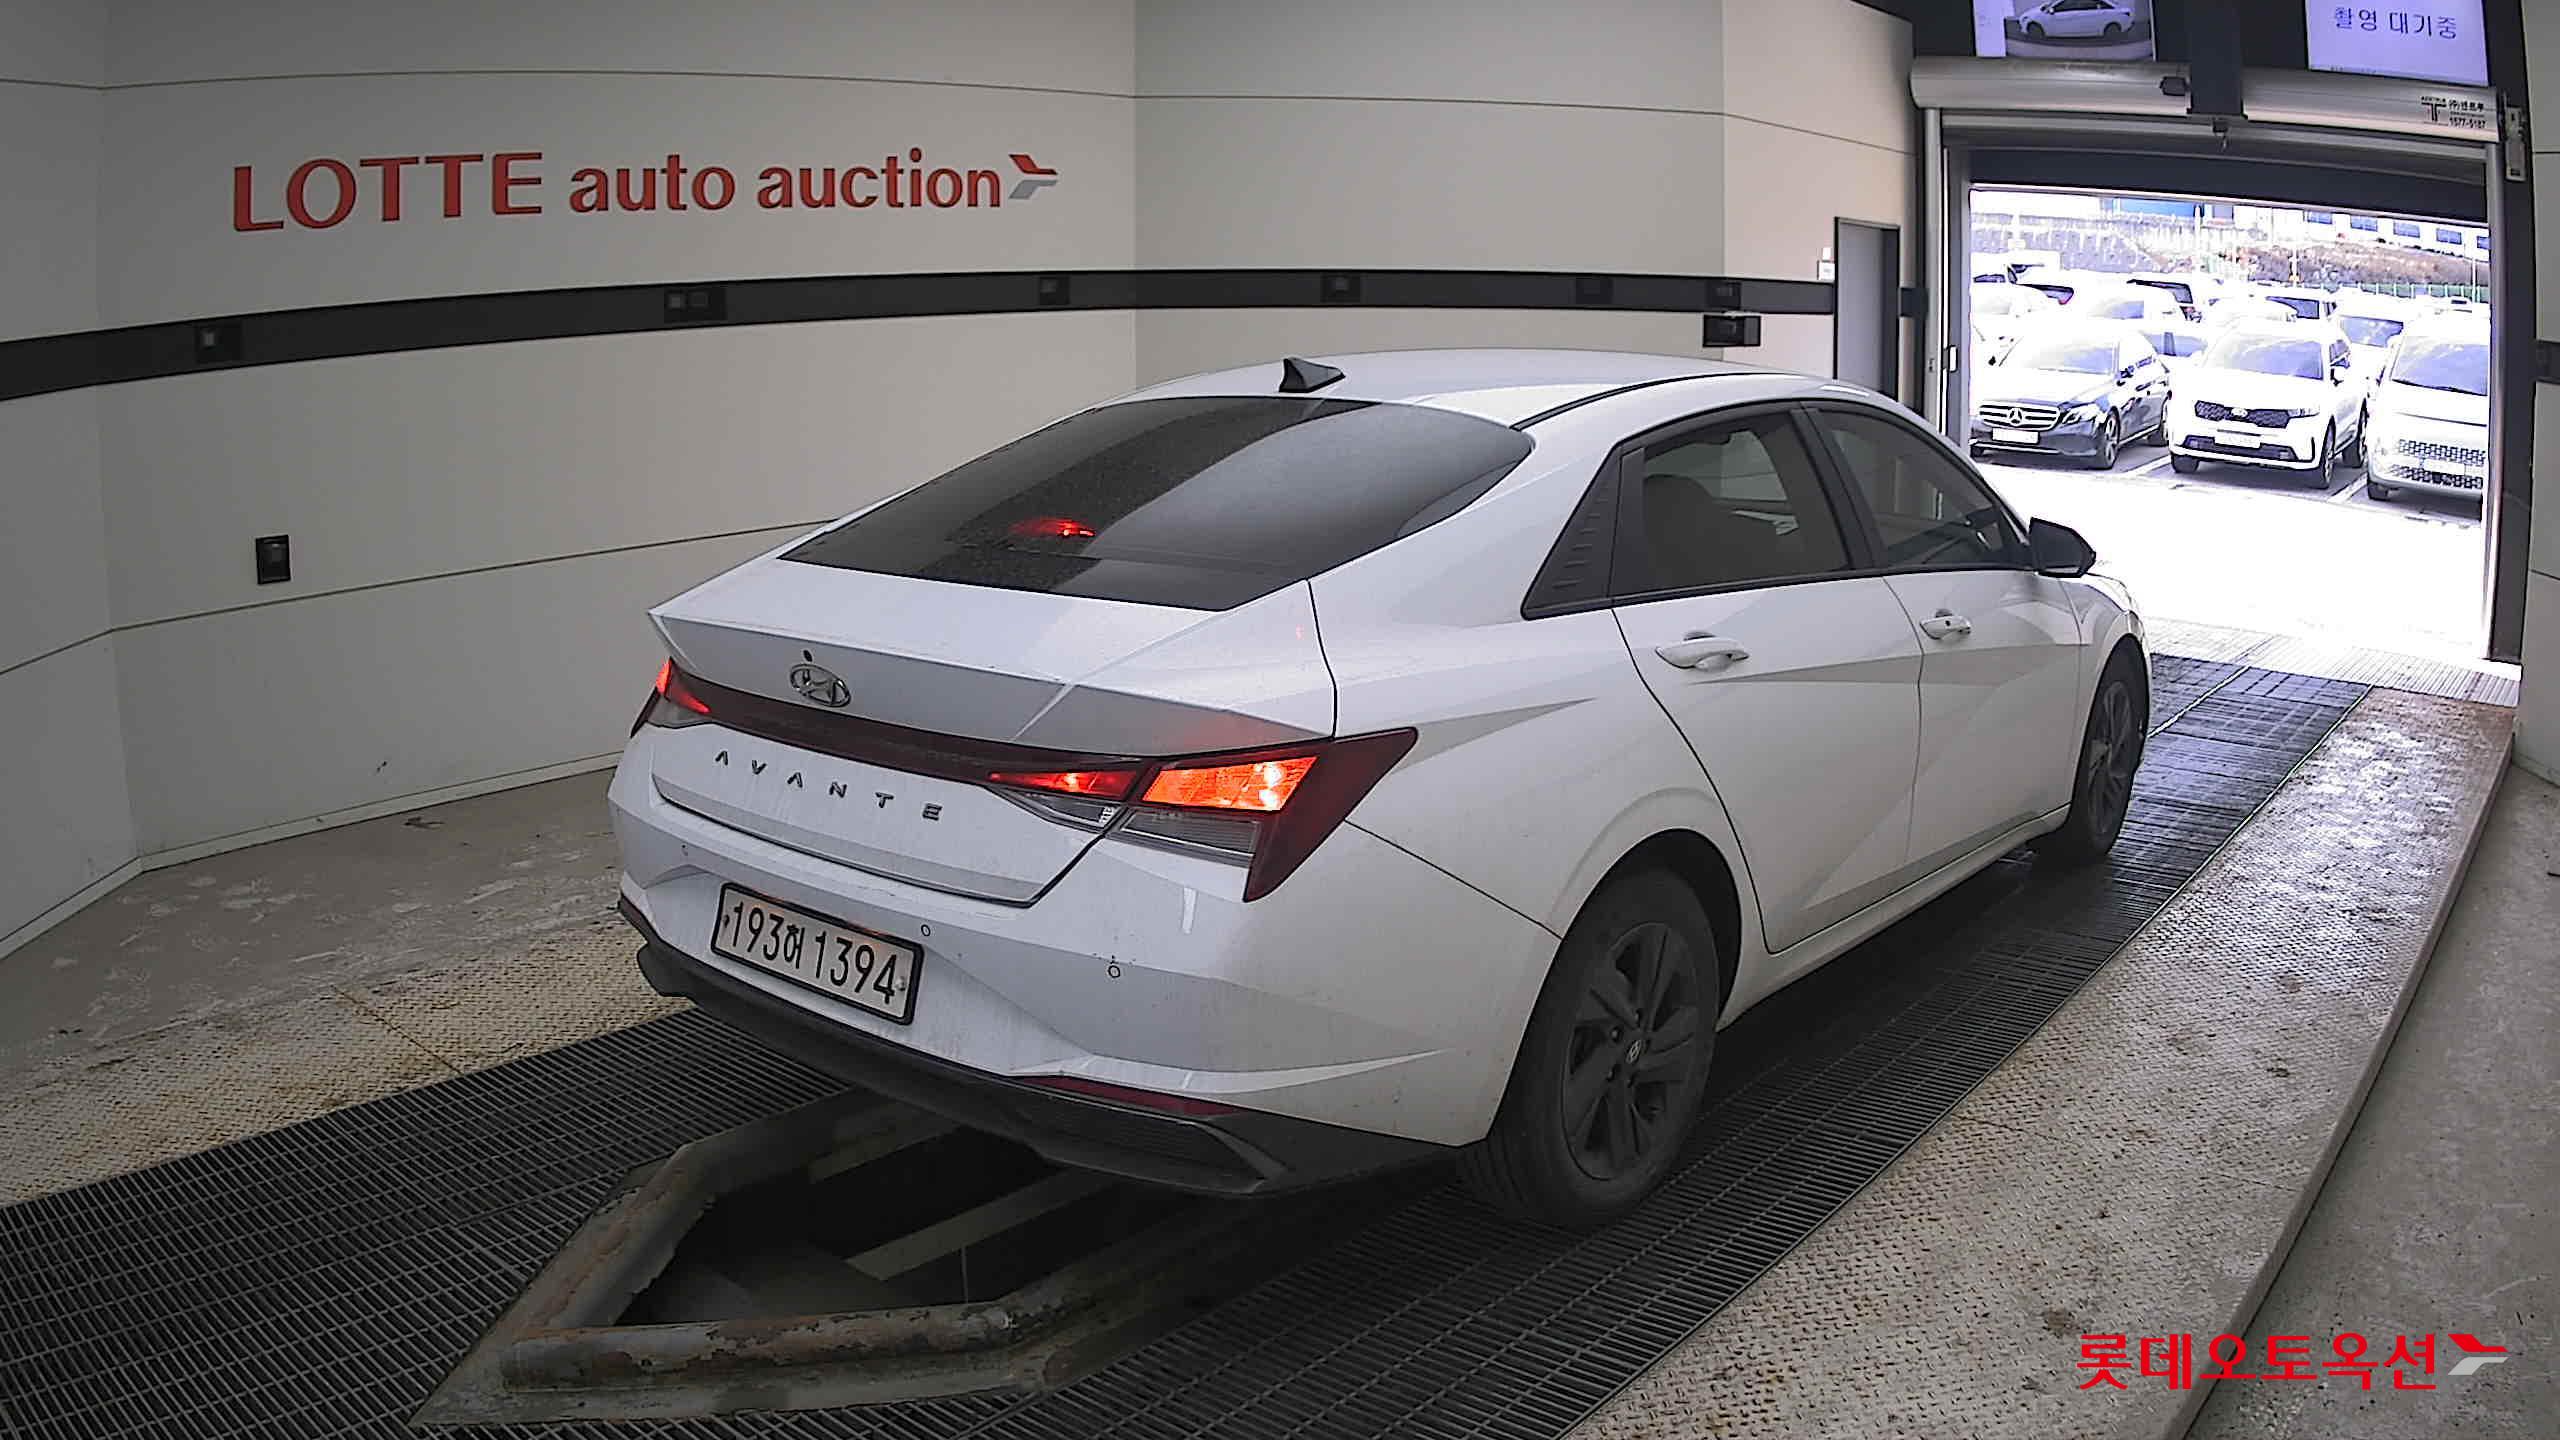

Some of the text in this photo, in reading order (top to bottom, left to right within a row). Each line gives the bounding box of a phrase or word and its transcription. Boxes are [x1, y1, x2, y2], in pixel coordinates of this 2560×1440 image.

[233, 147, 1002, 232] LOTTE auto auction
[715, 750, 943, 821] AVANTE
[815, 930, 898, 1005] 1394
